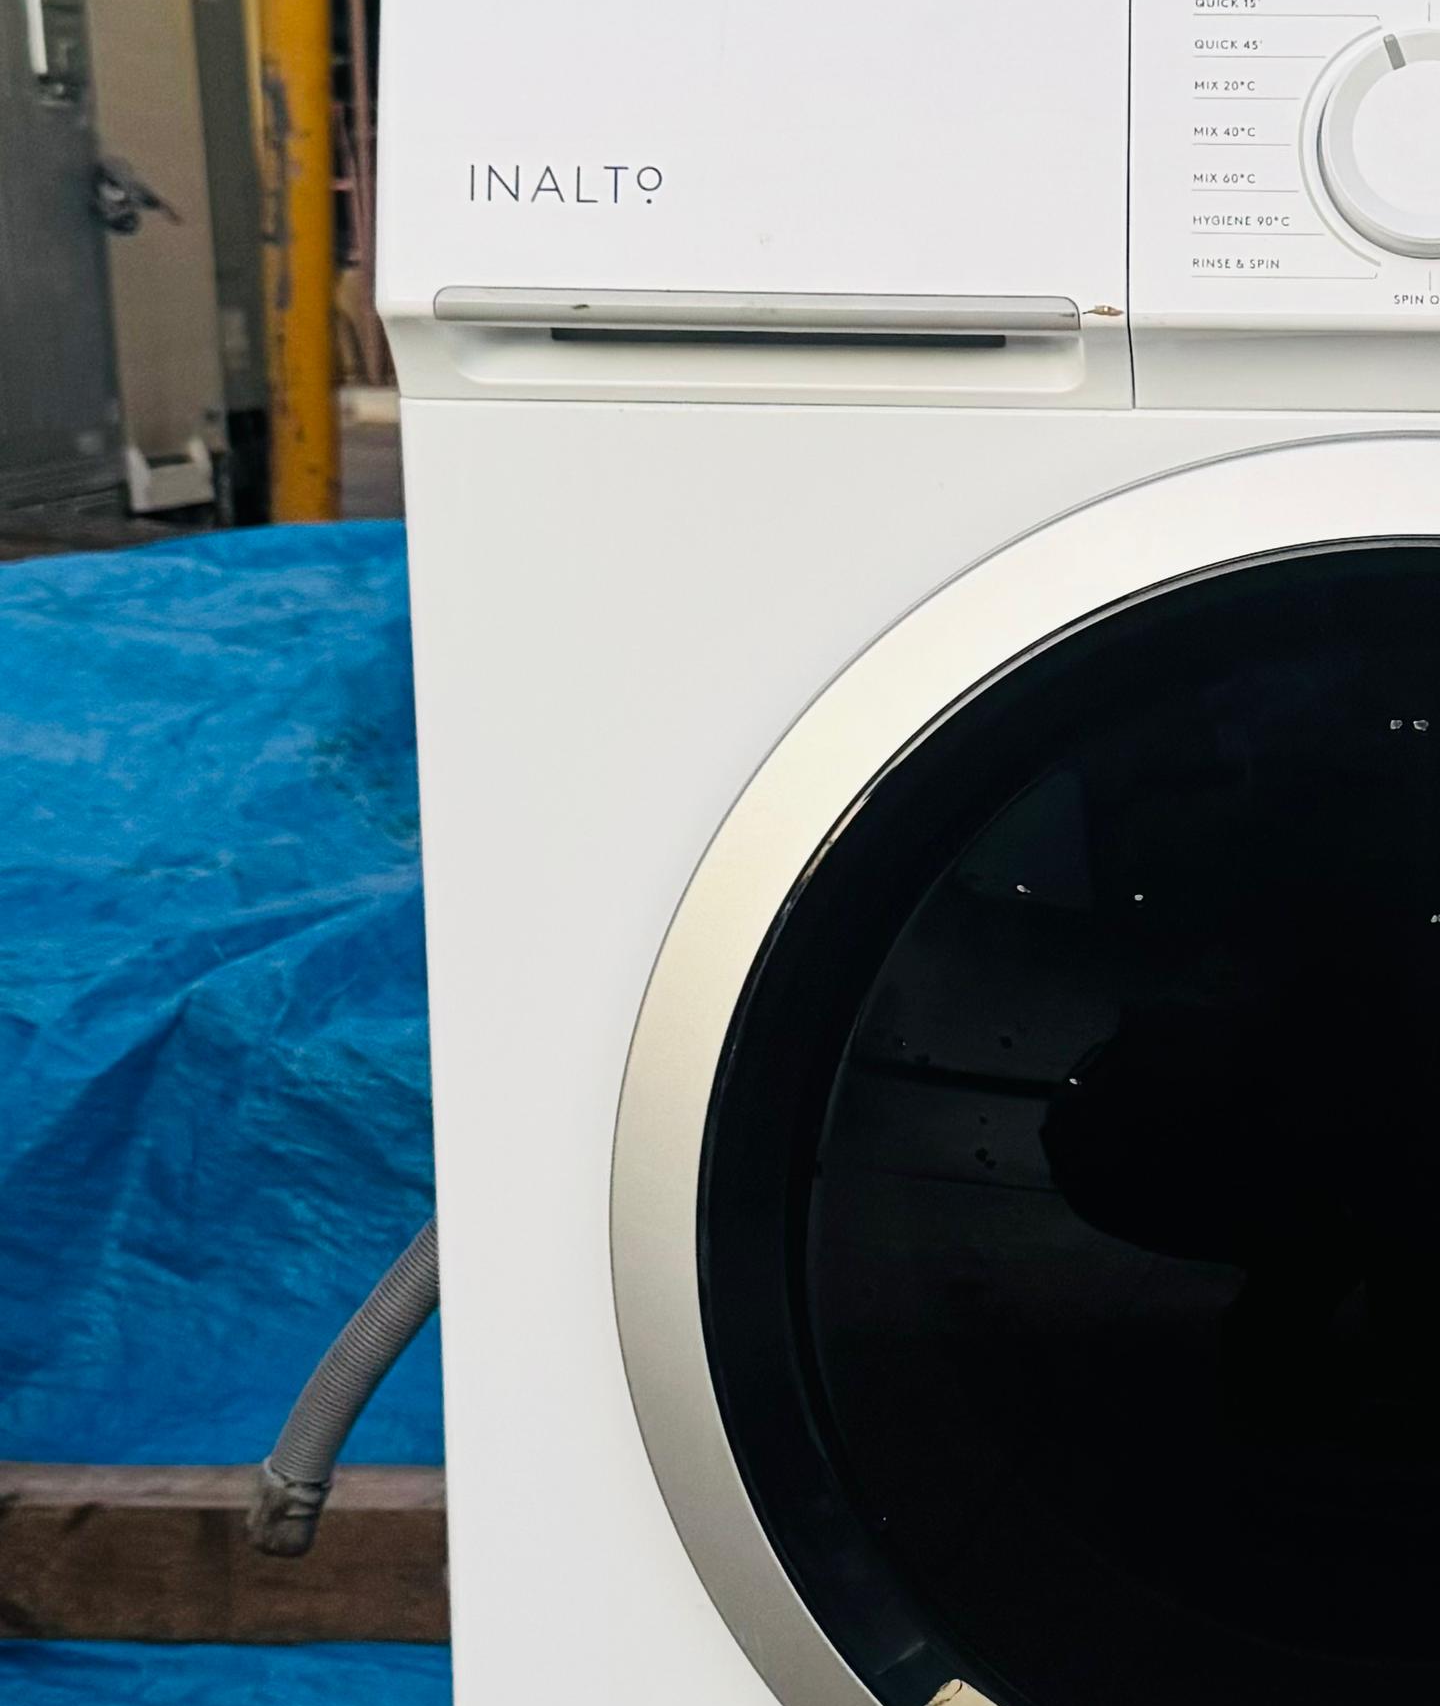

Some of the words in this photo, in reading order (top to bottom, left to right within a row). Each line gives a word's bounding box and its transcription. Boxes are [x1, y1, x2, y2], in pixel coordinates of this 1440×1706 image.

[1194, 39, 1238, 51] QUICK
[1194, 81, 1218, 91] MIX
[1222, 81, 1256, 91] 20°C
[1194, 127, 1218, 137] MIX
[1222, 127, 1256, 137] 40°C
[1193, 173, 1218, 184] MIX
[1222, 173, 1256, 184] 60°C
[1192, 215, 1252, 227] HYGIENE
[1257, 216, 1291, 227] 90°C
[1192, 259, 1233, 269] RINSE
[1237, 259, 1245, 269] &
[1248, 259, 1280, 269] SPIN
[1394, 295, 1425, 306] SPIN
